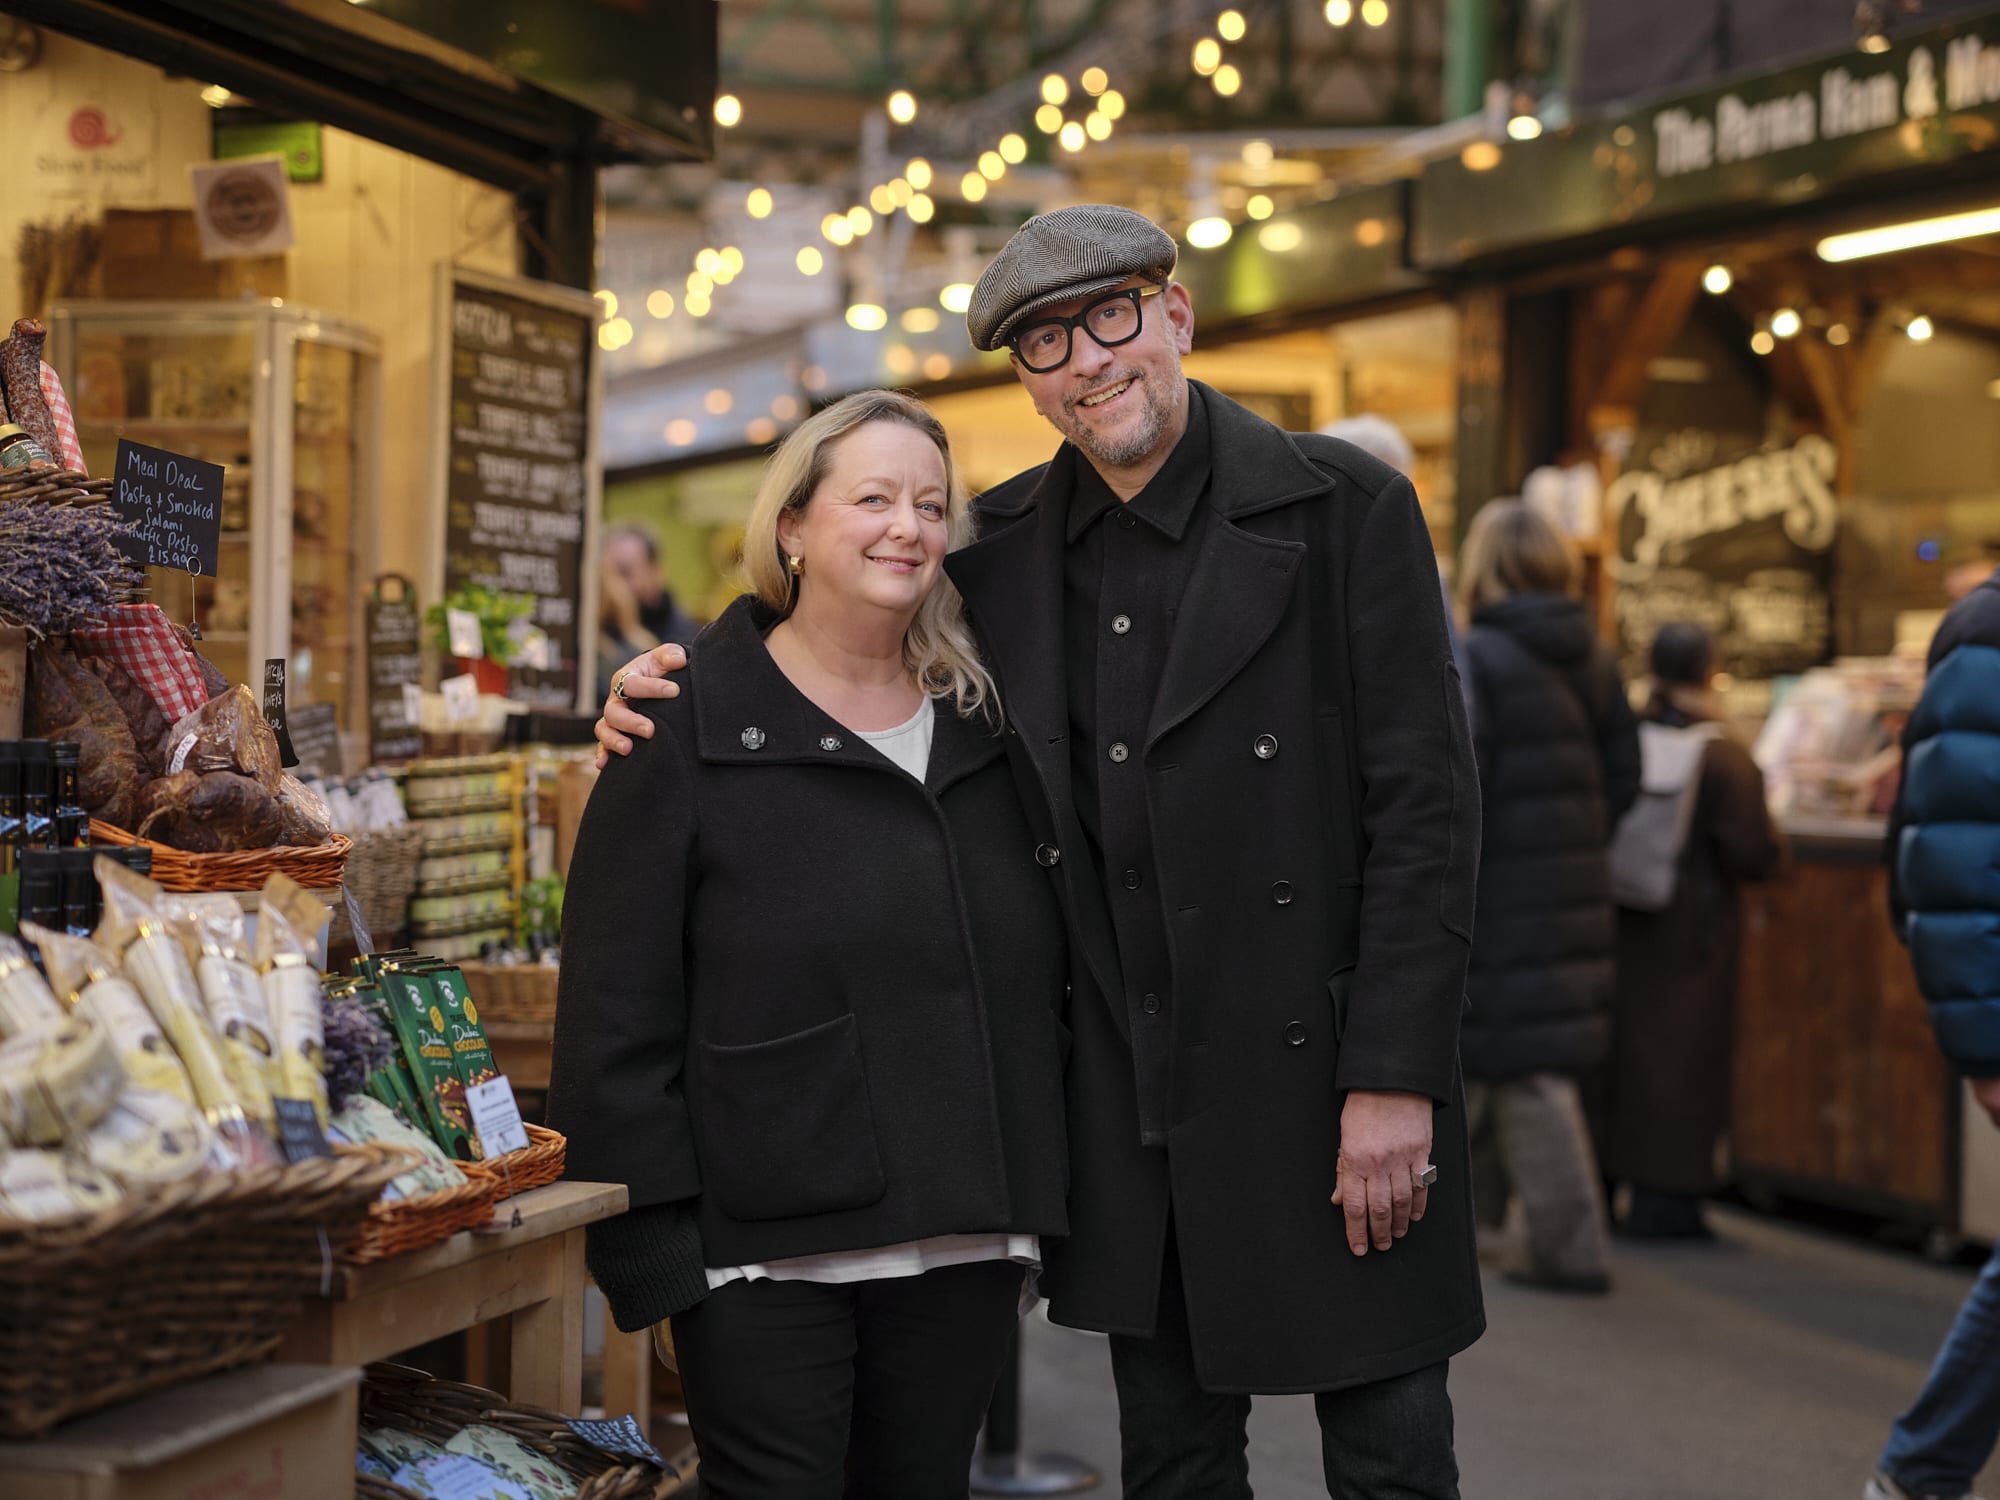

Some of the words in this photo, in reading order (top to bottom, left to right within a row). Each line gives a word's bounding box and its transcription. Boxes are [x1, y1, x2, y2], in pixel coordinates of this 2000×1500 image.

[1654, 106, 1713, 177] The
[1715, 92, 1816, 163] Parma
[1903, 46, 1938, 118] &
[128, 450, 158, 479] Meal
[120, 478, 152, 506] Pasta
[166, 492, 214, 520] Smoked
[145, 507, 183, 532] Salami
[168, 531, 199, 555] Pesto
